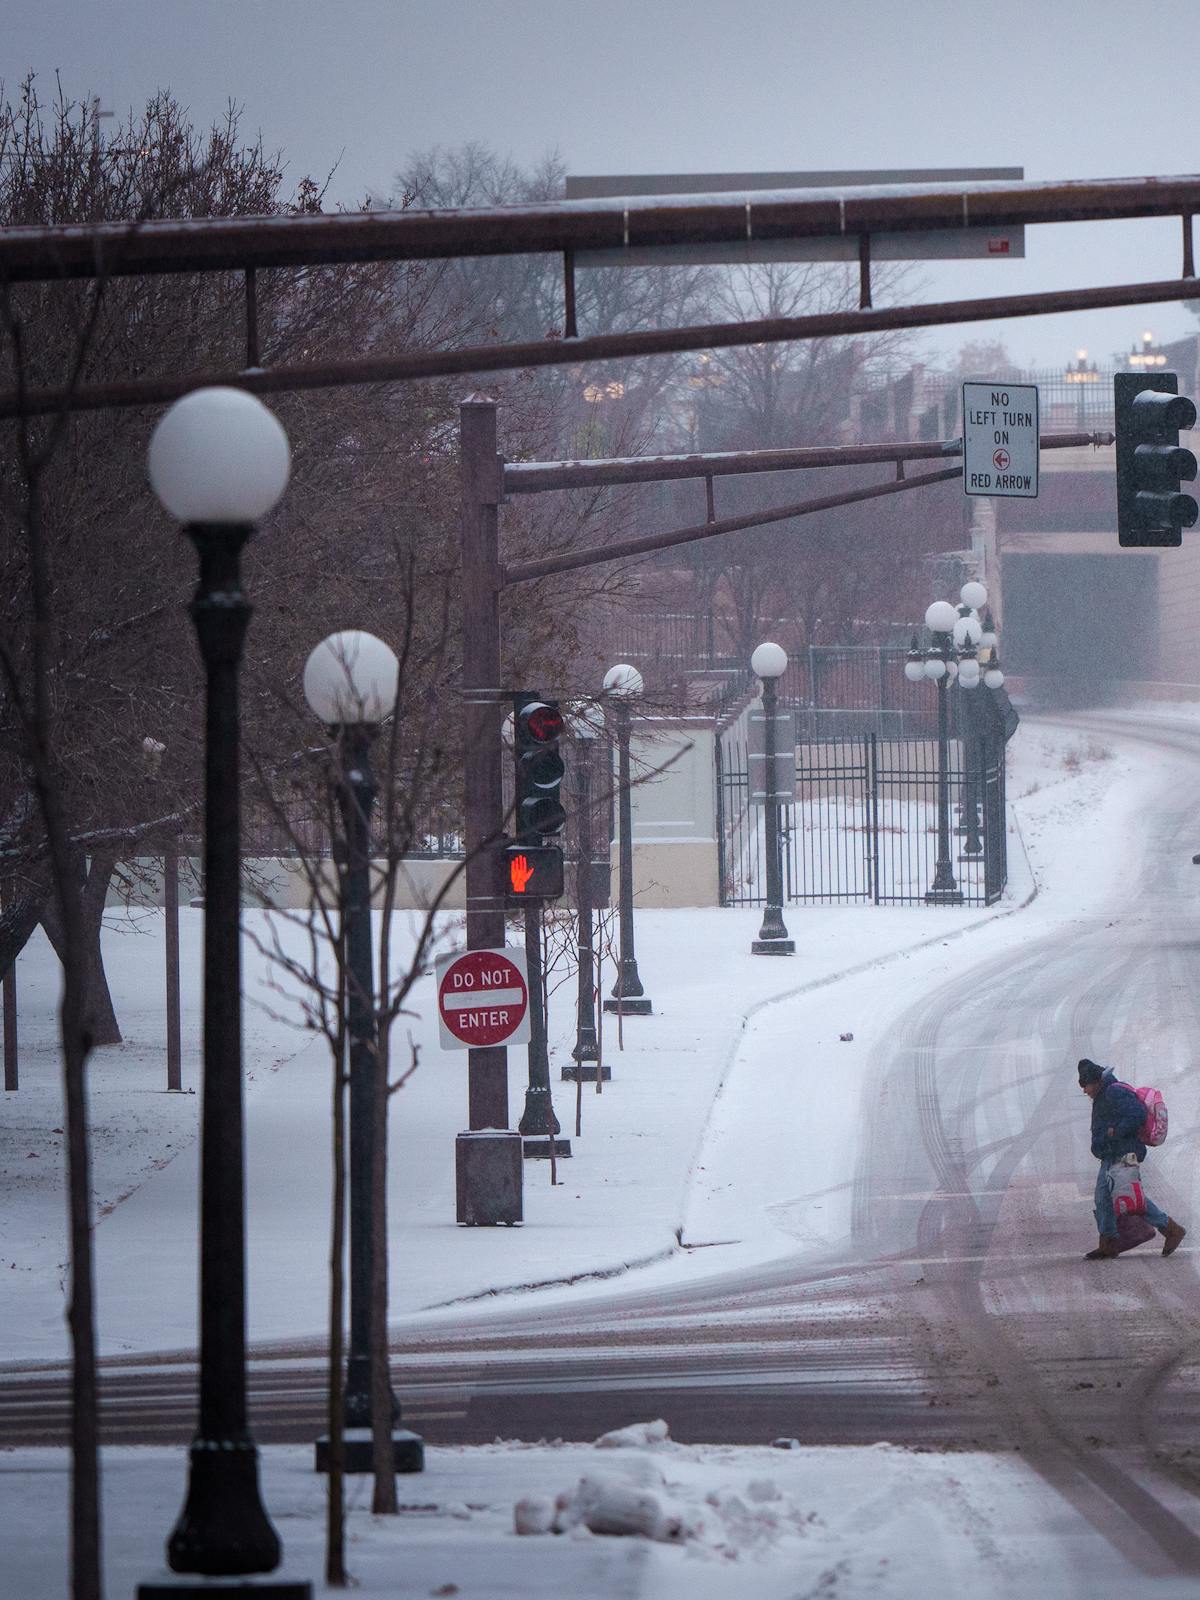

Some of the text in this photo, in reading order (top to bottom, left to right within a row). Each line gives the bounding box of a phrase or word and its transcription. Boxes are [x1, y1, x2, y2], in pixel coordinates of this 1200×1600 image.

[991, 392, 1010, 407] NO
[970, 410, 1032, 427] LEFT TURN
[994, 430, 1009, 445] ON
[971, 473, 1032, 490] RED ARROW
[453, 969, 511, 988] DO NOT
[459, 1010, 509, 1029] ENTER
